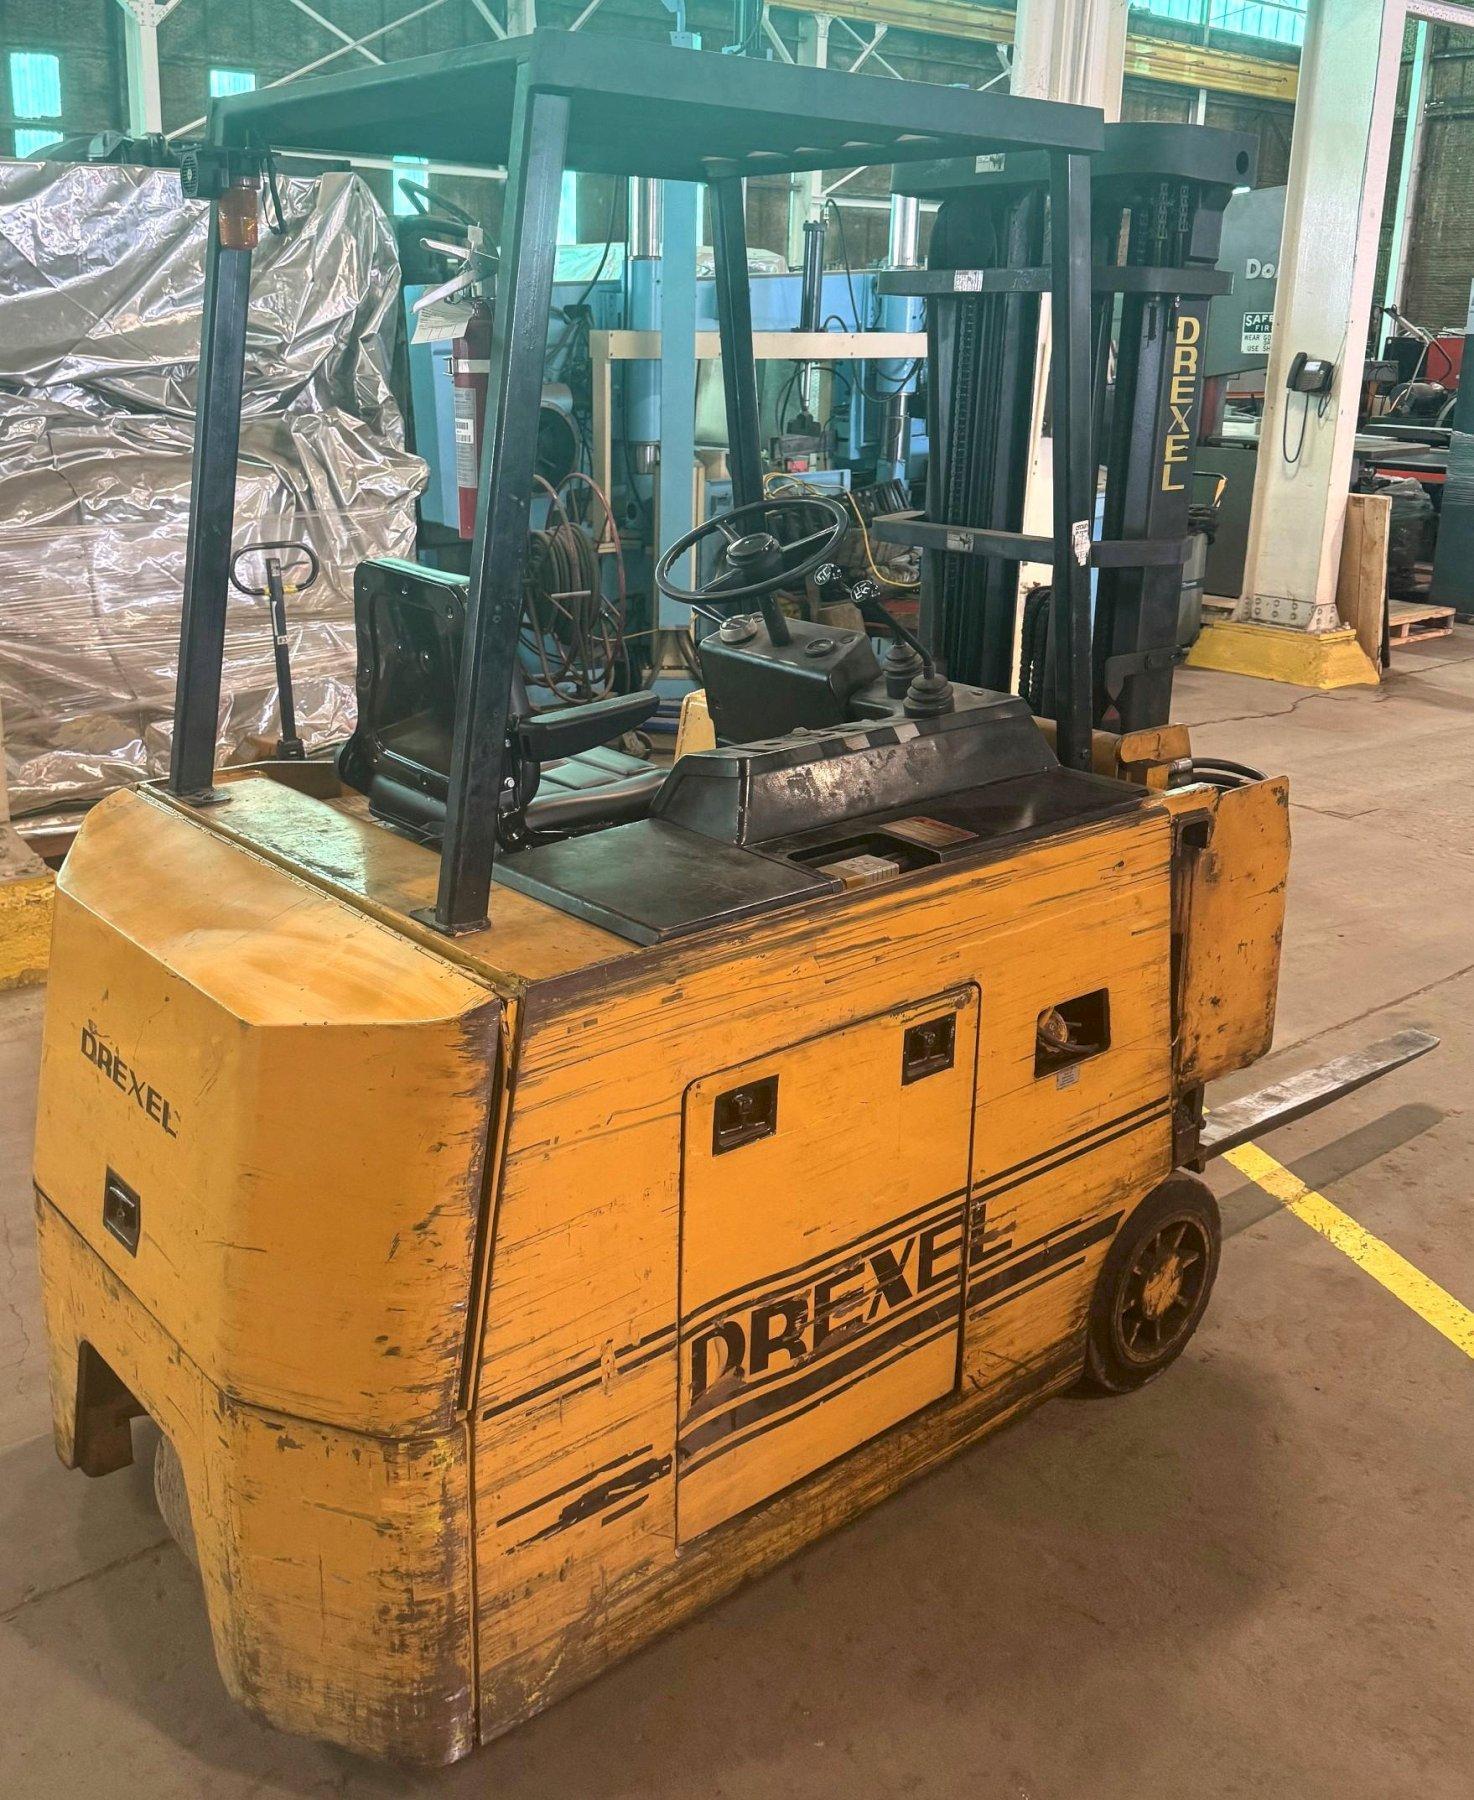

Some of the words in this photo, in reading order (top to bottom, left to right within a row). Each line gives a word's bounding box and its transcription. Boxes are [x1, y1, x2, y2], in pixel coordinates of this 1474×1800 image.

[1161, 316, 1200, 491] DREXEL
[81, 1026, 177, 1139] DREXEL
[690, 1203, 1014, 1408] DREXEL
